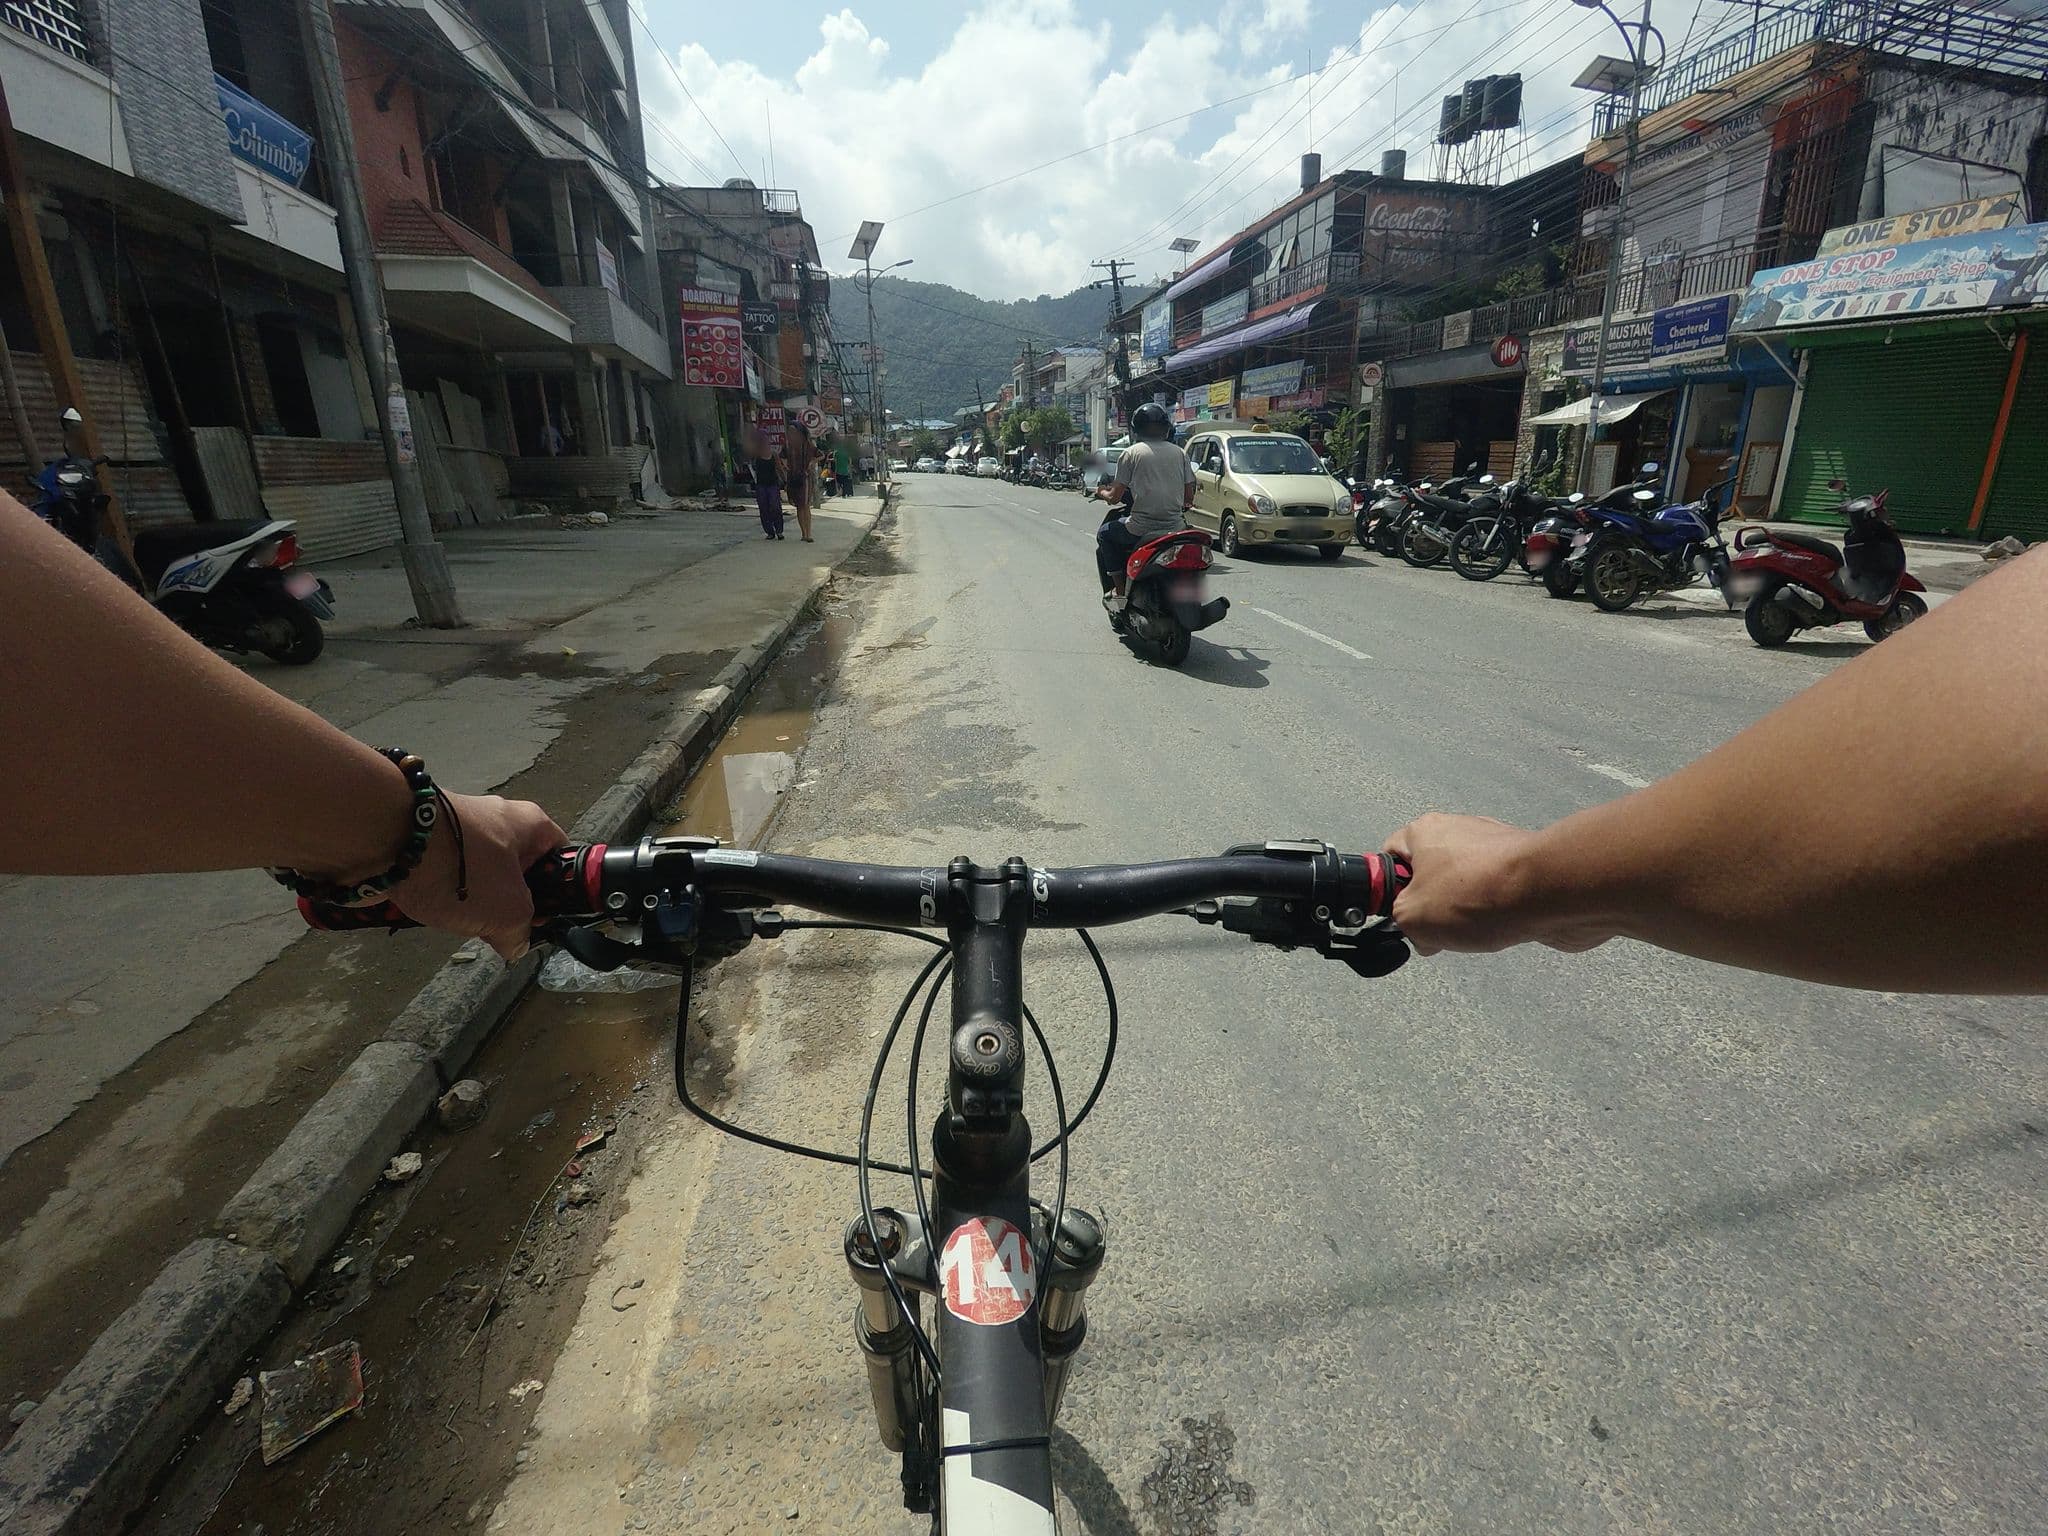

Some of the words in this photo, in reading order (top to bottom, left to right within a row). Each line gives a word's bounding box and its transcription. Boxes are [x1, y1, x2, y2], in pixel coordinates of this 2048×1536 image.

[223, 107, 304, 178] Columbia
[1843, 219, 1897, 247] ONE
[1905, 203, 1980, 236] STOP
[1779, 261, 1826, 286] ONE
[1828, 248, 1897, 277] STOP
[1807, 279, 1860, 297] Trekking
[1865, 266, 1941, 288] Equipment
[1949, 261, 1987, 278] Shop
[682, 288, 722, 304] ROADWAY
[743, 312, 775, 324] TATTOO
[1669, 318, 1710, 338] Chartered
[1577, 329, 1600, 345] UPPE
[1608, 322, 1653, 341] MUSTANG
[1674, 338, 1700, 350] Exchange
[1701, 333, 1725, 345] Counter
[1500, 341, 1518, 361] illy
[941, 1231, 1036, 1305] 14
